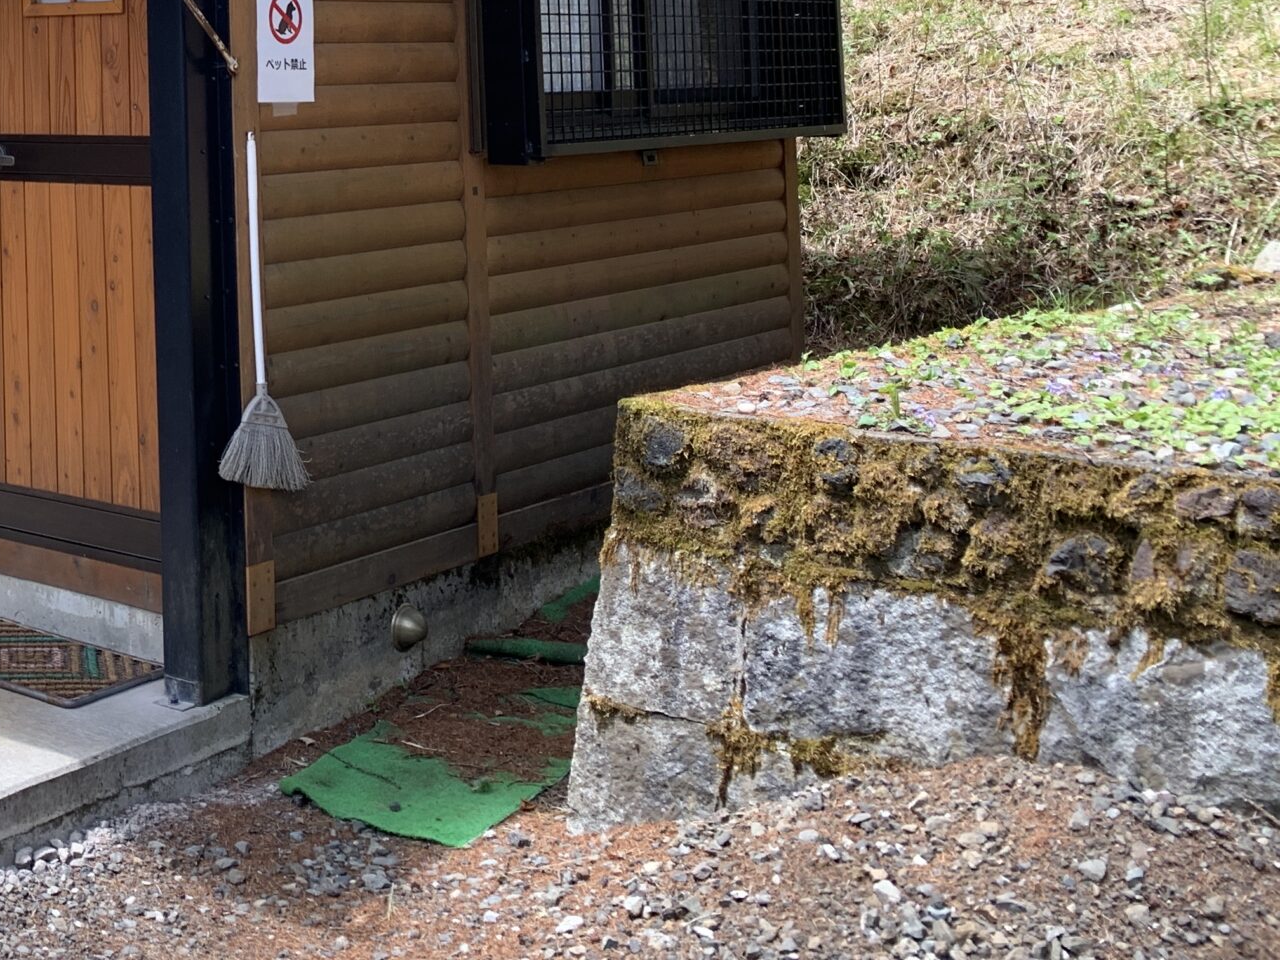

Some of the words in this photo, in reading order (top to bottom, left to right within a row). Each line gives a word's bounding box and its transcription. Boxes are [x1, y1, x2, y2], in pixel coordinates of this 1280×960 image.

[265, 58, 307, 70] ペット禁止
